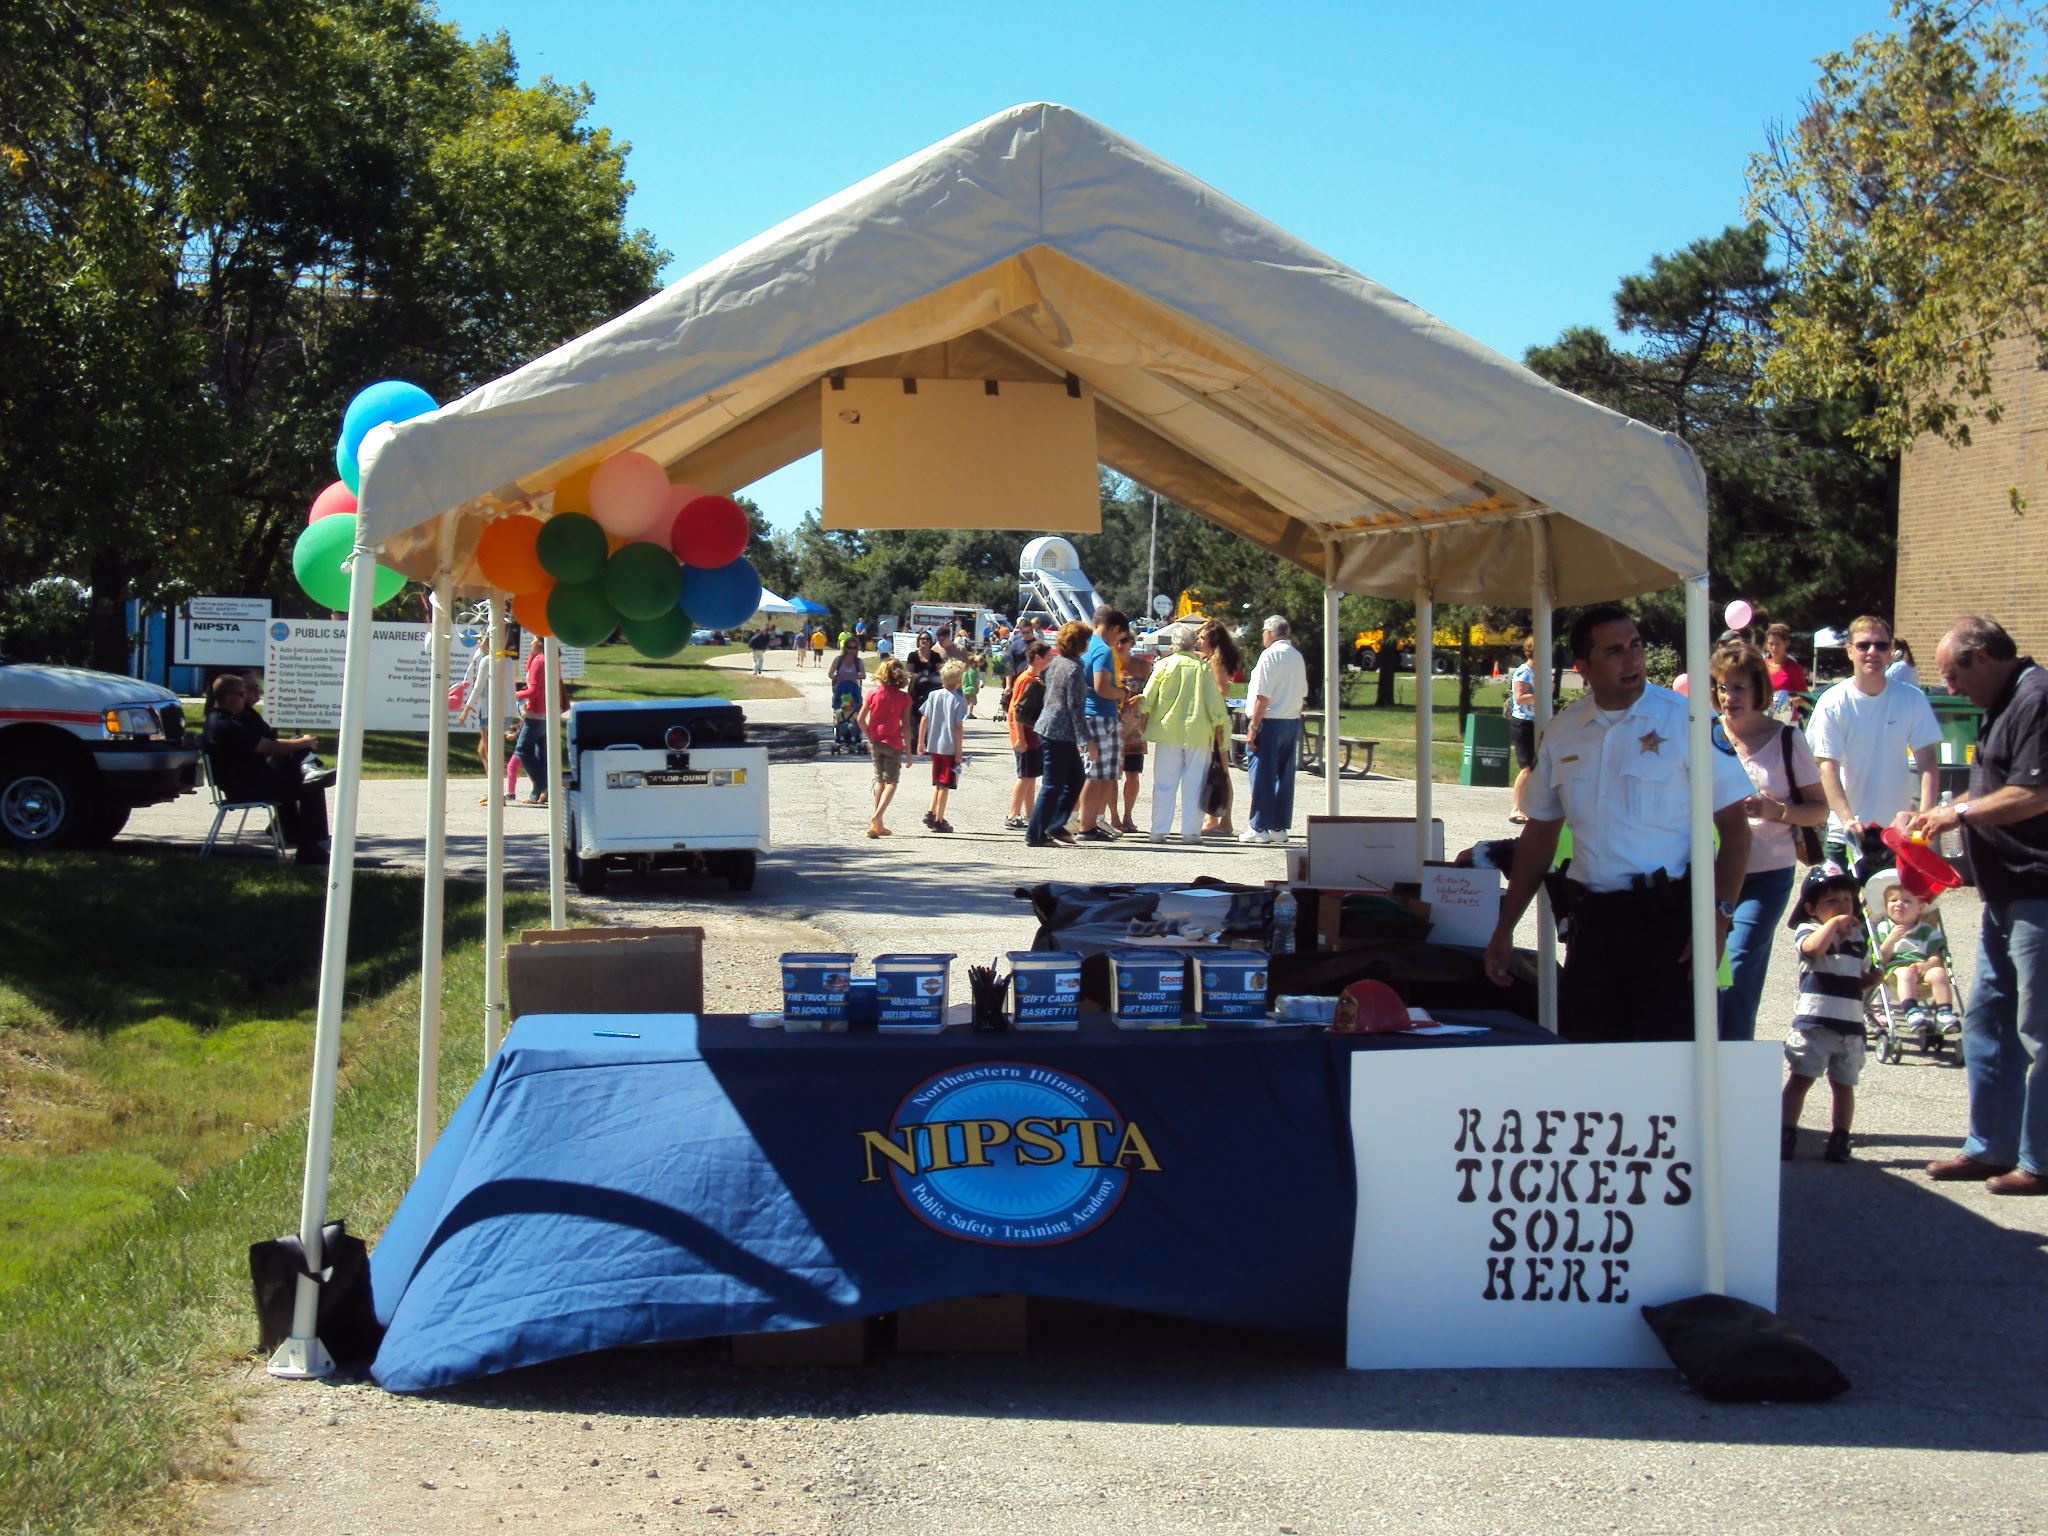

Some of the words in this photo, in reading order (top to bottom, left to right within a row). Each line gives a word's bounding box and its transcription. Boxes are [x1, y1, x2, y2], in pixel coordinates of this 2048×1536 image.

[193, 622, 240, 632] NIPSTA
[295, 627, 330, 639] PUBLIC
[372, 630, 429, 642] AWARENES
[649, 774, 708, 783] TAYLOR-DUNN
[787, 993, 803, 1002] FIRE
[804, 993, 827, 1002] TRUCK
[827, 993, 845, 1002] RIDE
[1022, 995, 1047, 1004] GIFT
[1047, 994, 1076, 1003] CARD
[1138, 992, 1167, 1000] COSTCO
[791, 1006, 801, 1015] TO
[801, 1006, 829, 1015] SCHOOL
[1020, 1007, 1061, 1016] BASKET
[1123, 1005, 1140, 1013] GIFT
[1140, 1005, 1168, 1013] BASKET
[912, 1067, 1021, 1108] Northeastern
[1029, 1068, 1089, 1104] Illinois
[1454, 1108, 1677, 1160] RAFFLE
[855, 1117, 1165, 1183] NIPSTA
[1455, 1158, 1692, 1206] TICKETS
[911, 1182, 947, 1221] Public
[948, 1212, 996, 1238] Safety
[1001, 1219, 1072, 1240] Training
[1071, 1177, 1115, 1226] Academy
[1488, 1207, 1634, 1254] SOLD
[1482, 1256, 1630, 1304] HERE
